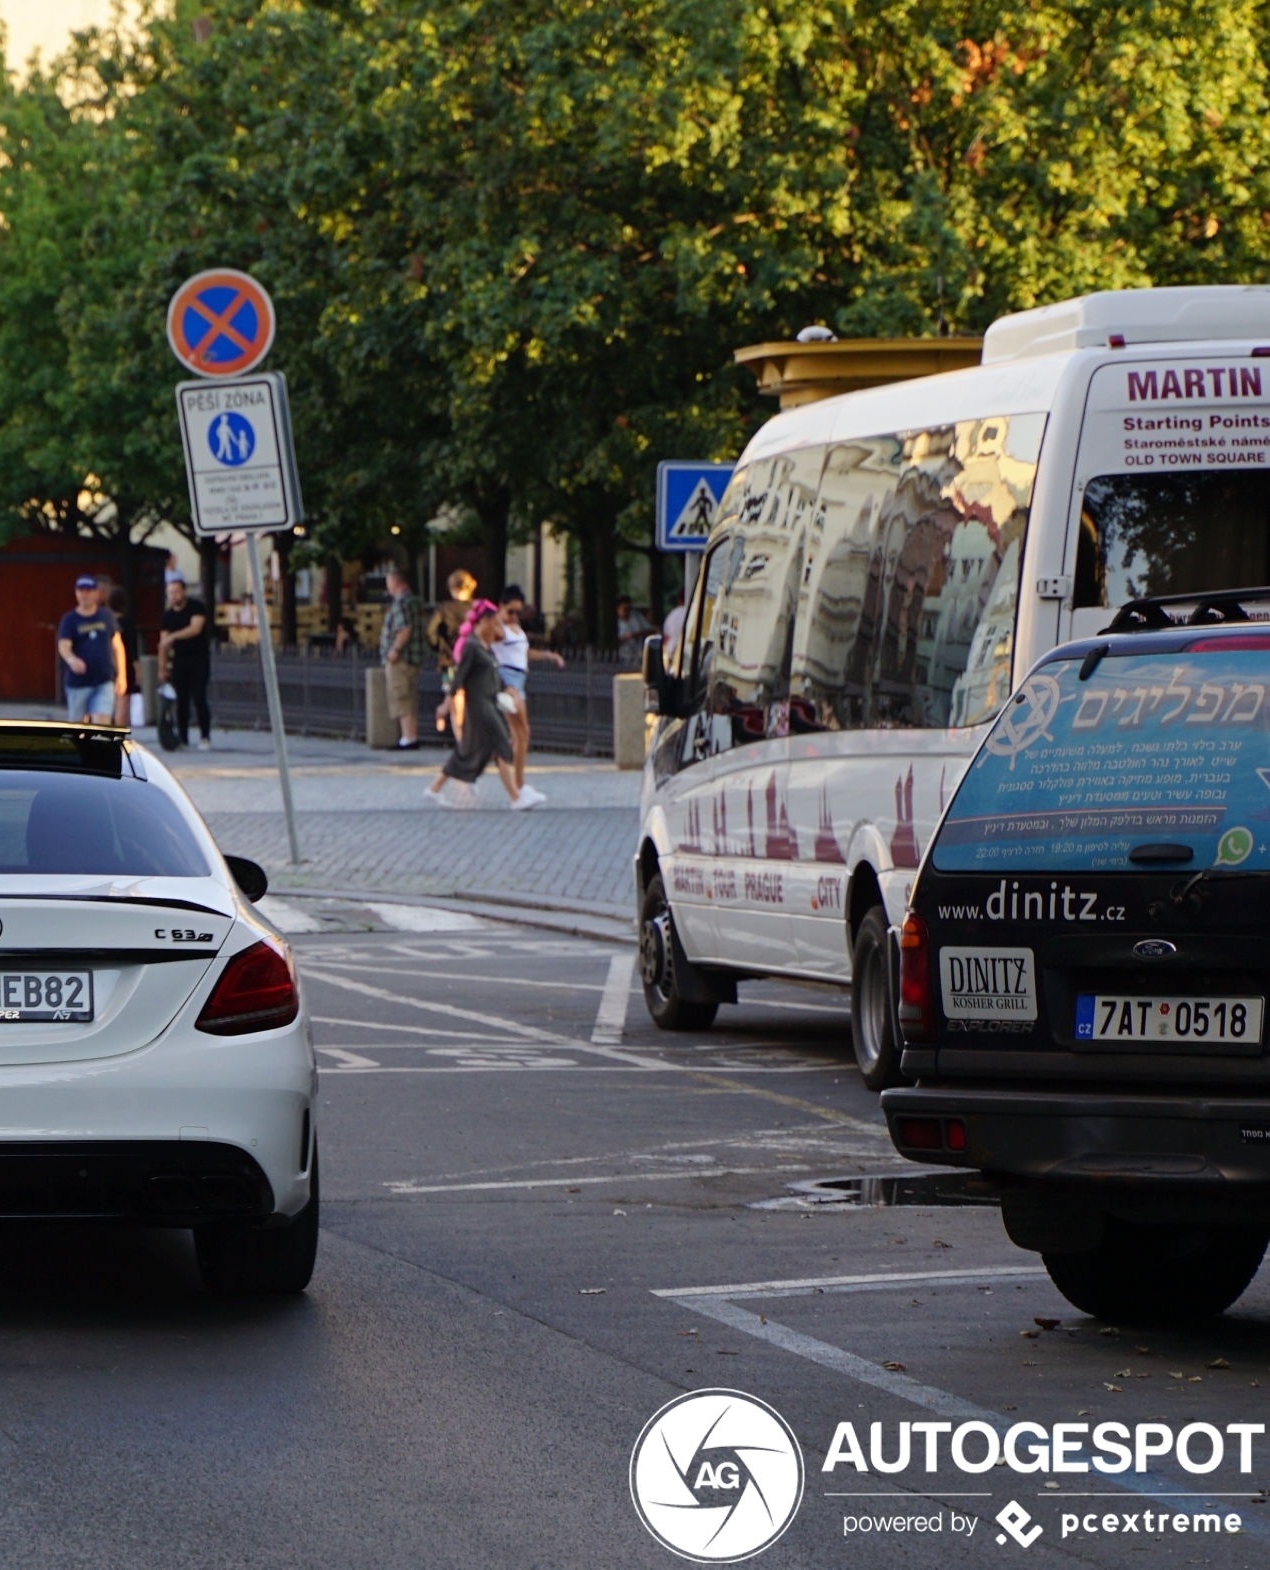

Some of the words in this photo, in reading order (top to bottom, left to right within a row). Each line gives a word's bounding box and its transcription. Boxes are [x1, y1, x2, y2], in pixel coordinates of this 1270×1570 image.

[1127, 367, 1262, 401] MARTIN
[187, 392, 220, 411] PĚŠÍ
[224, 389, 266, 408] ZÓNA
[1123, 415, 1203, 432] Starting
[1209, 414, 1270, 429] Points
[1124, 435, 1226, 449] Staroměstské
[1125, 455, 1155, 466] OLD
[1159, 454, 1202, 465] TOWN
[1207, 452, 1266, 464] SQUARE
[1072, 667, 1266, 728] מפליגים
[1040, 745, 1085, 758] משעתיים
[1087, 740, 1122, 755] למעלה
[1131, 742, 1160, 754] נשכח
[1163, 739, 1188, 753] בלתי
[1188, 739, 1215, 752] בילוי
[1218, 739, 1242, 751] ערב
[1024, 747, 1039, 760] של
[1030, 761, 1070, 775] בהדרכה
[1073, 759, 1101, 771] מלווה
[1102, 757, 1147, 770] הוולטבה
[1150, 757, 1170, 768] נהר
[1174, 755, 1205, 770] לאורך
[1210, 755, 1237, 767] שייט
[997, 779, 1034, 793] ססגונית
[1037, 776, 1075, 790] פולקלור
[1077, 775, 1115, 788] באווירת
[1116, 773, 1152, 787] מוזיקה
[1154, 773, 1182, 785] מופע
[1058, 793, 1082, 806] דיניץ
[1084, 791, 1129, 804] ממסעדת
[1131, 790, 1162, 802] וטעים
[1165, 790, 1192, 801] עשיר
[1194, 789, 1226, 800] ובופה
[1006, 819, 1049, 832] ובמסעדת
[1058, 816, 1078, 832] שלך
[1080, 815, 1108, 830] המלון
[1109, 813, 1143, 828] בדלפק
[1146, 814, 1176, 826] מראש
[1179, 813, 1217, 825] הזמנות
[983, 822, 1005, 836] דיניץ
[1001, 844, 1023, 860] לרציף
[1025, 845, 1045, 855] חזרה
[1050, 842, 1075, 854] 19:20
[1084, 841, 1110, 855] לסיפון
[1110, 841, 1131, 852] עליה
[975, 848, 999, 860] 22:00
[713, 869, 738, 899] TOUR
[744, 872, 784, 904] PRAGUE
[817, 876, 842, 909] CITY
[938, 880, 1125, 921] www.dinitz.cz
[154, 929, 167, 939] C
[948, 957, 1027, 994] DINITZ
[952, 996, 995, 1009] KOSHER
[996, 998, 1028, 1010] GRILL
[1078, 1023, 1091, 1034] CZ
[1099, 1001, 1153, 1036] 7AT
[1174, 1002, 1248, 1038] 0518
[946, 1020, 1034, 1034] EXPLORER
